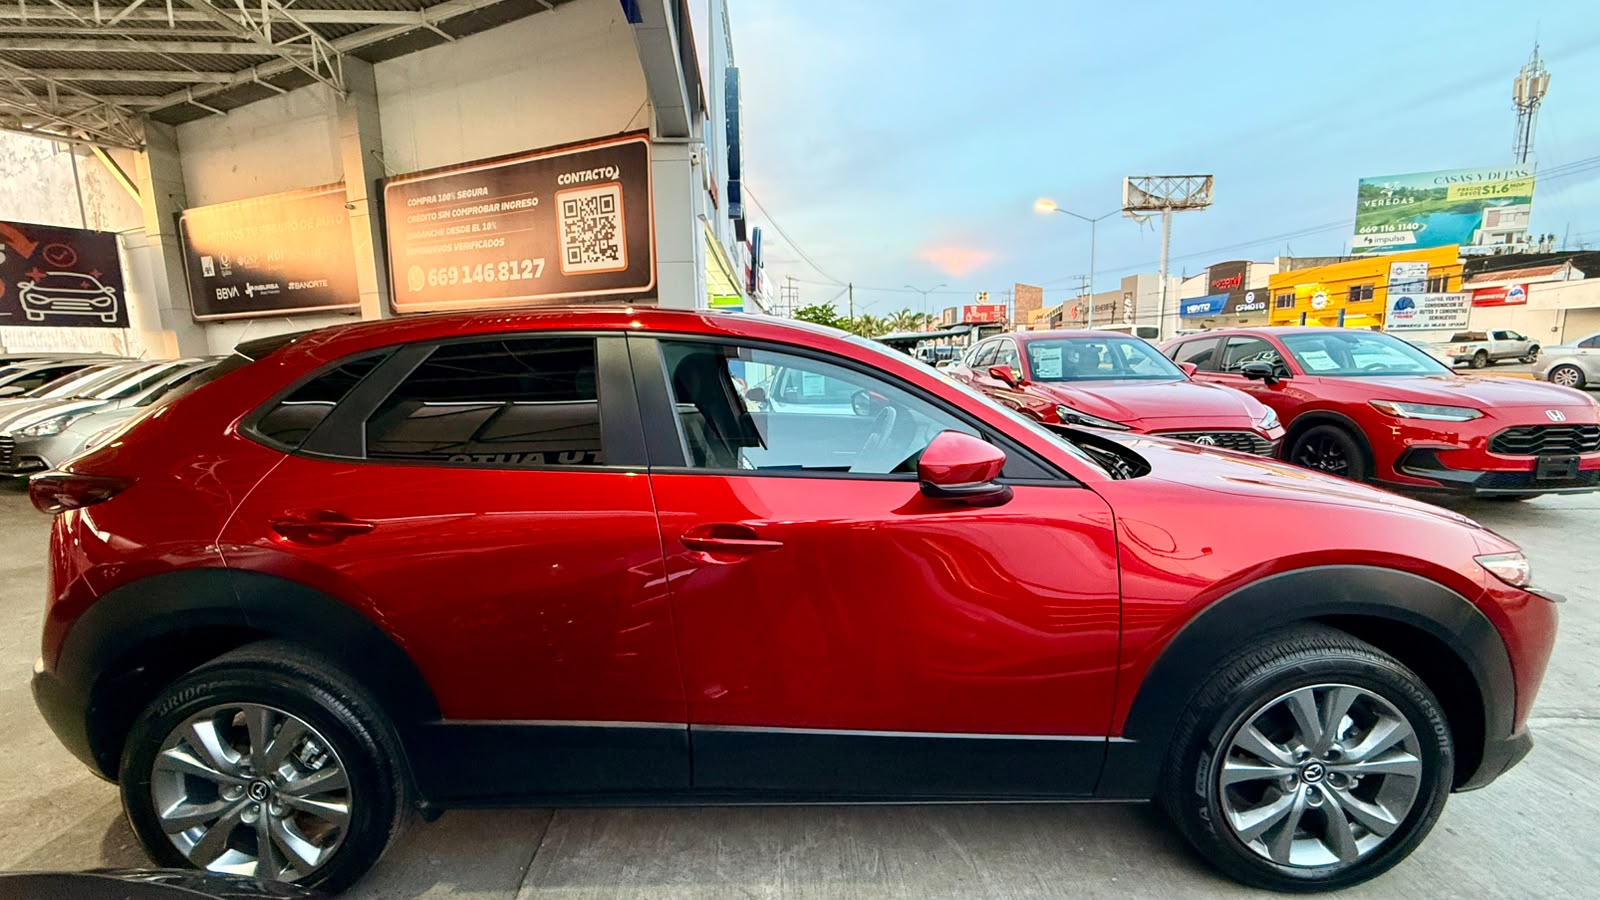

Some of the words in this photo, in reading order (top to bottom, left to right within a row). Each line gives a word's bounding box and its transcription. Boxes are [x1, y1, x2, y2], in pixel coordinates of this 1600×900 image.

[557, 166, 614, 186] CONTACTO
[1433, 173, 1472, 185] CASAS
[407, 195, 438, 207] COMPRA
[438, 191, 456, 202] 100%
[456, 186, 489, 200] SEGURA
[1364, 197, 1414, 207] VEREDAS
[438, 210, 451, 220] SIN
[451, 202, 500, 218] COMPROBAR
[500, 196, 539, 211] INGRESO
[316, 214, 344, 228] AUTO
[446, 224, 471, 234] DESDE
[472, 224, 481, 232] EL
[482, 221, 497, 231] 10%
[1359, 226, 1378, 234] 669
[1398, 223, 1419, 231] 1140
[454, 238, 505, 252] VERIFICADOS
[427, 258, 546, 287] 669.146.8127
[216, 285, 240, 300] BBVA
[294, 280, 328, 290] BANORTE
